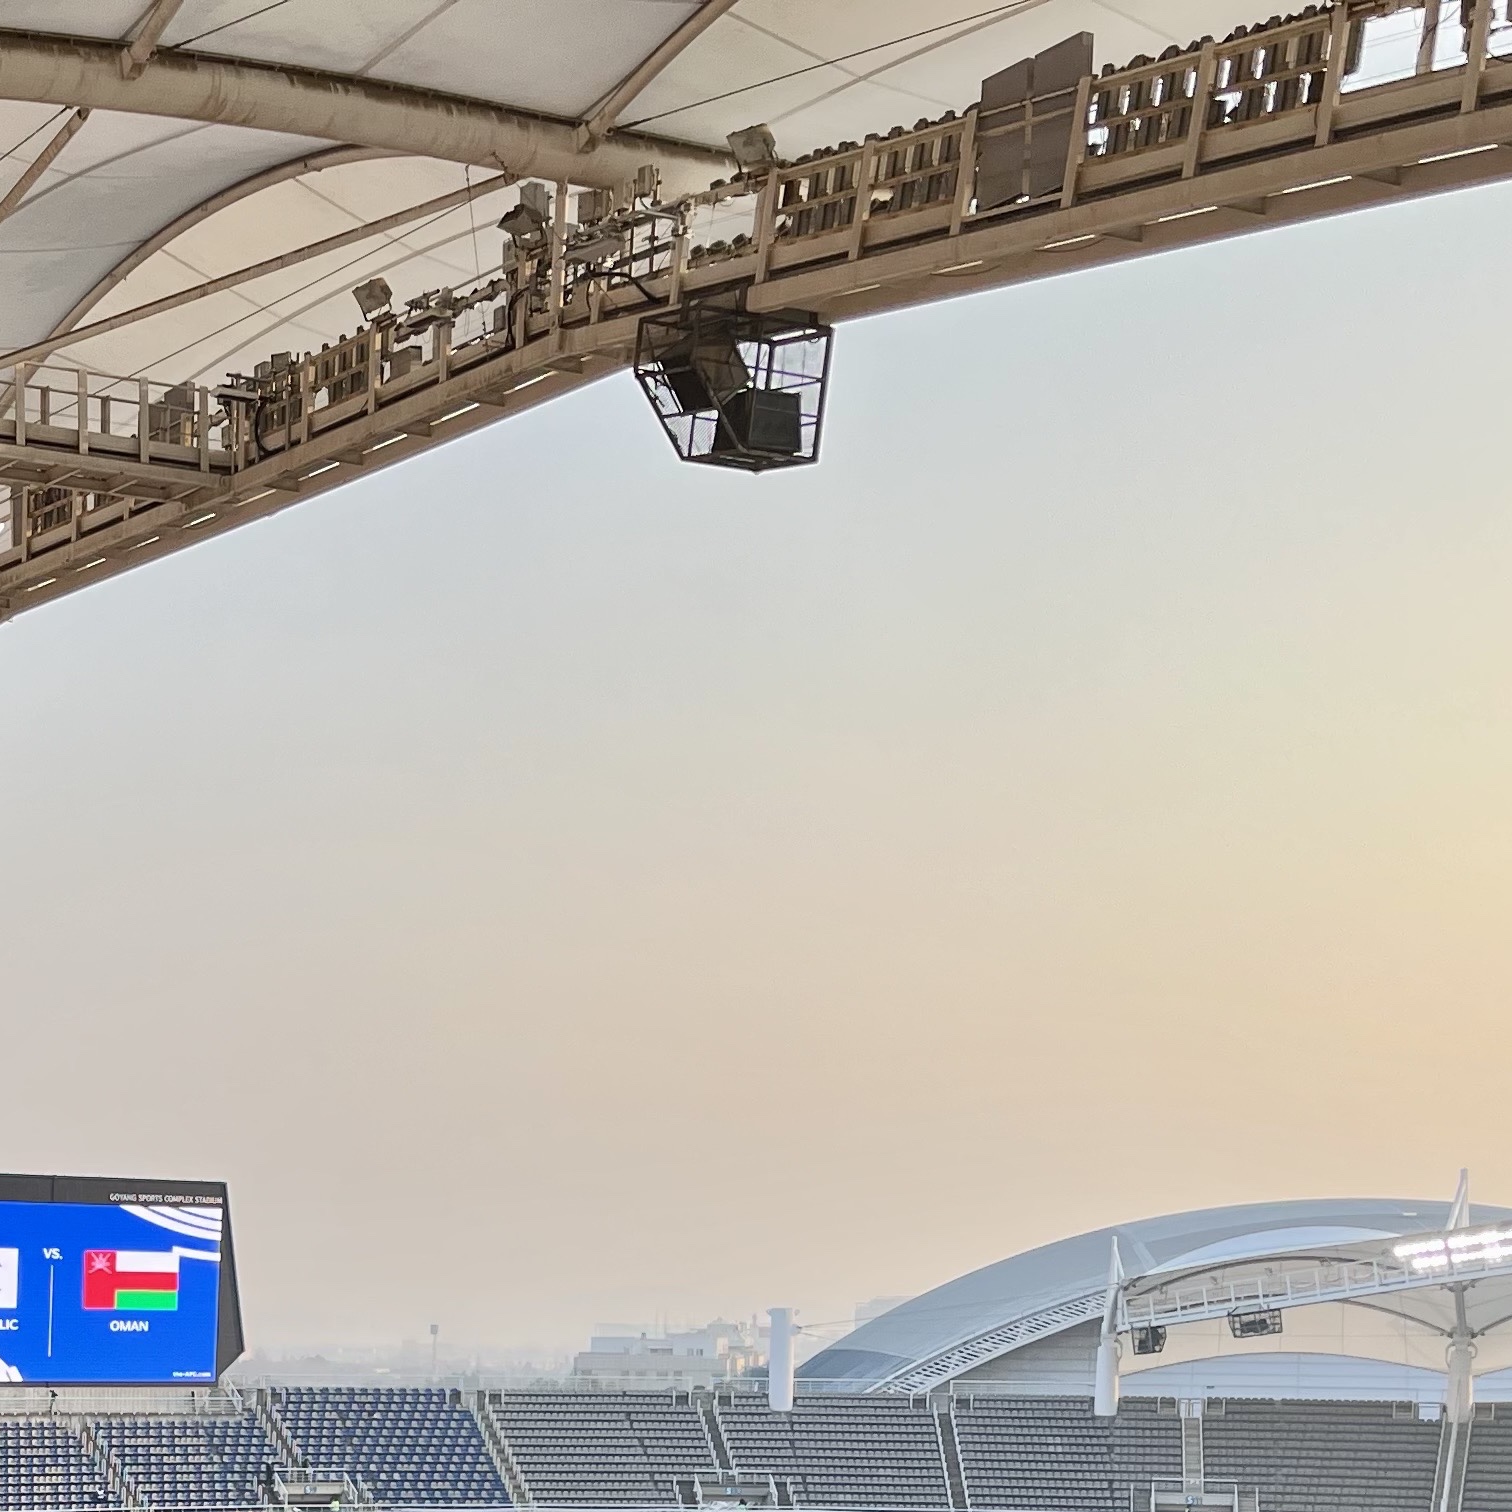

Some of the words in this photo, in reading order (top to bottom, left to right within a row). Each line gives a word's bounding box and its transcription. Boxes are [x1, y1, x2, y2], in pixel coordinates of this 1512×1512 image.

[110, 1193, 137, 1202] GOYANG
[138, 1194, 163, 1203] SPORTS
[164, 1195, 193, 1204] COMPLEX
[43, 1248, 63, 1260] VS.
[110, 1320, 148, 1332] OMAN
